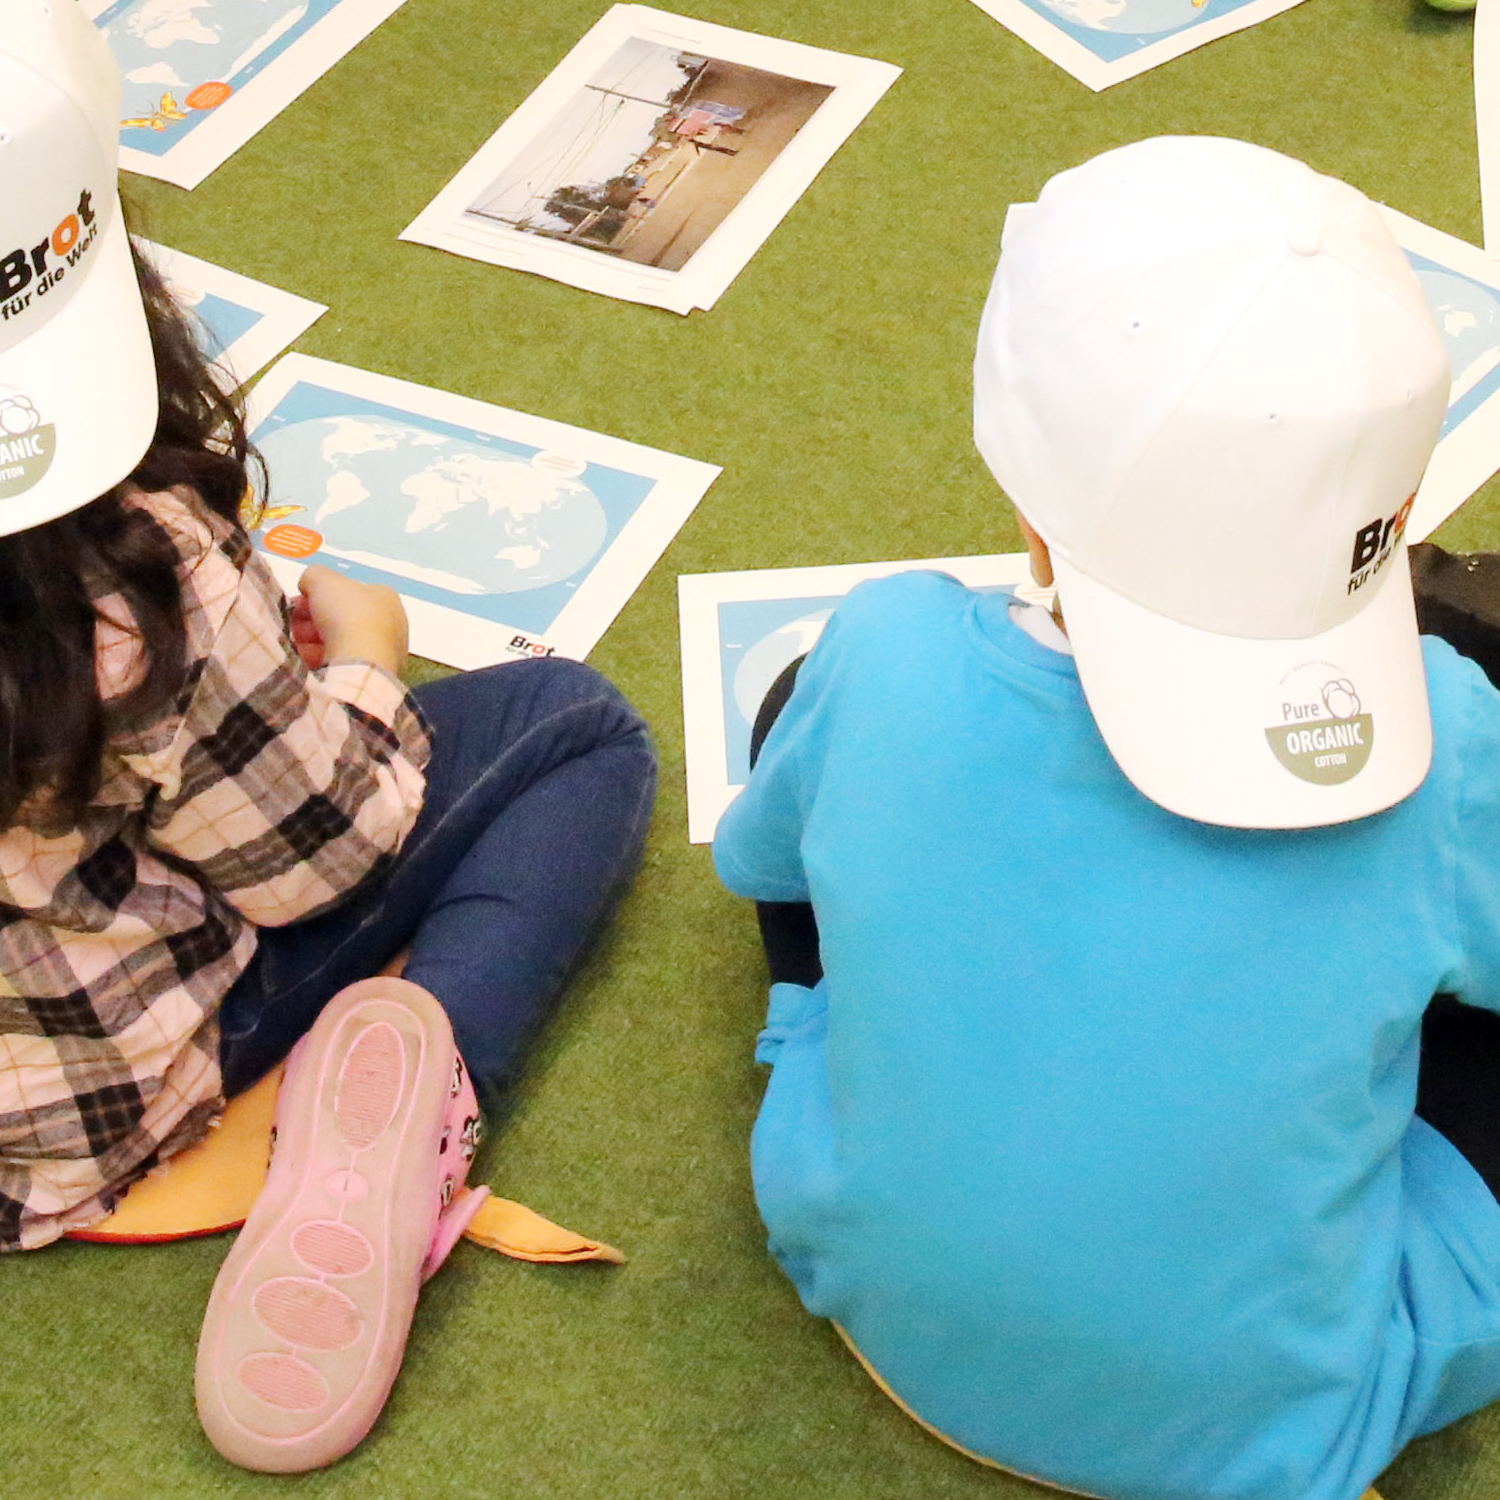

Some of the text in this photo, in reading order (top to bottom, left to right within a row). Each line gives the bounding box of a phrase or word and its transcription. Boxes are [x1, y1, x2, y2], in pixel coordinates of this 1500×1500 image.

[1, 223, 98, 321] für die Welt
[1282, 702, 1320, 721] Pure
[1286, 722, 1365, 755] ORGANIC
[1314, 753, 1348, 768] COTTON
